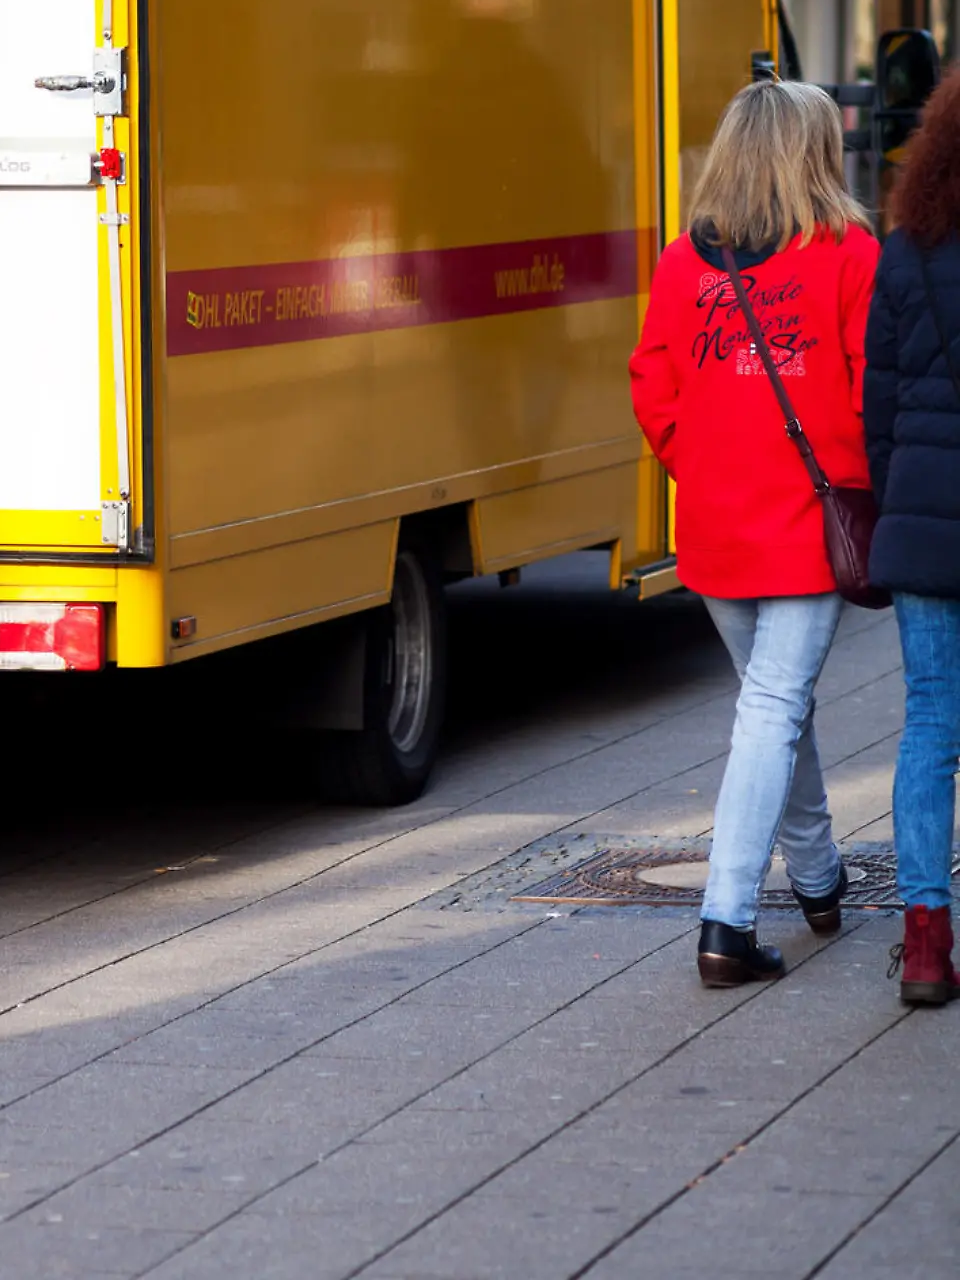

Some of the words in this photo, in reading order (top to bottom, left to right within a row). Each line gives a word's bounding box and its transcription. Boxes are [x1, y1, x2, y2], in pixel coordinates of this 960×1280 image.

[493, 252, 566, 299] www.dhl.de
[196, 293, 222, 329] DHL
[224, 289, 265, 327] PAKET
